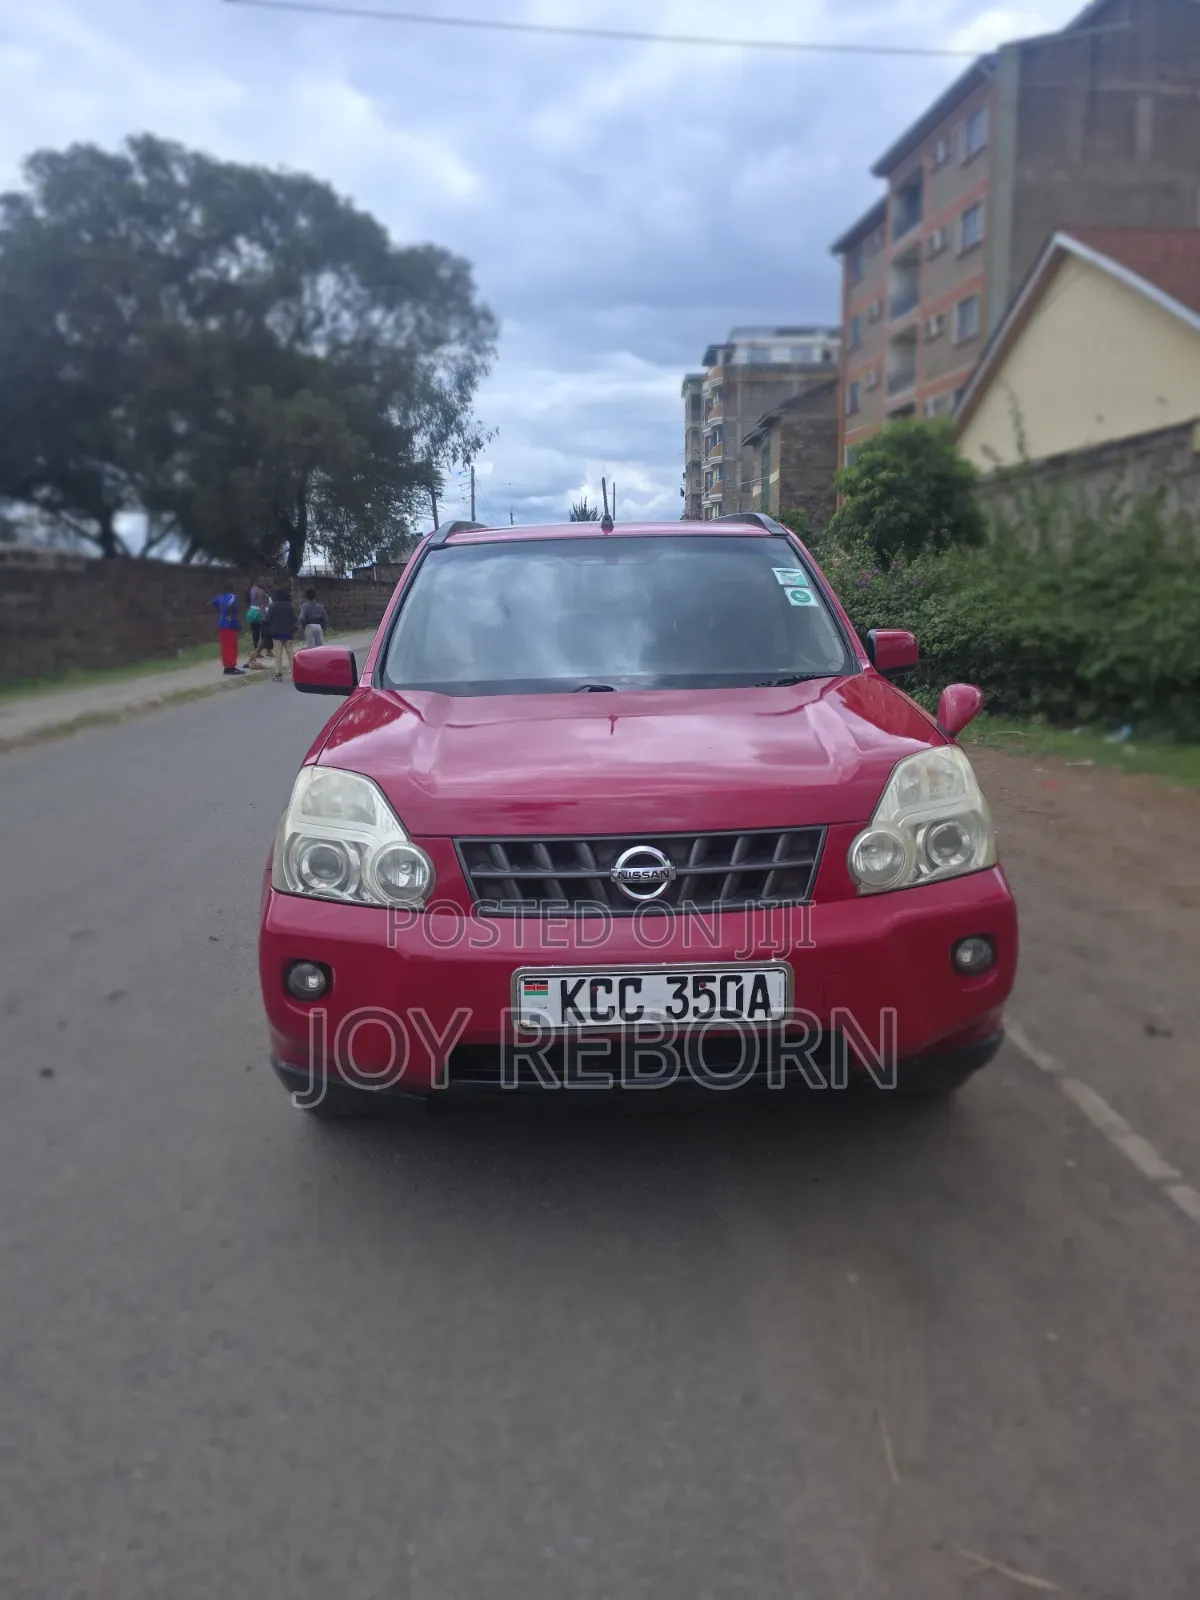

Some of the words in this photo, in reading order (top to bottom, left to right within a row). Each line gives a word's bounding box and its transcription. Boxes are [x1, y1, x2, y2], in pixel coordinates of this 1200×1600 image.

[618, 870, 670, 880] NISSAN
[560, 977, 645, 1024] KCC
[665, 974, 773, 1020] 350A
